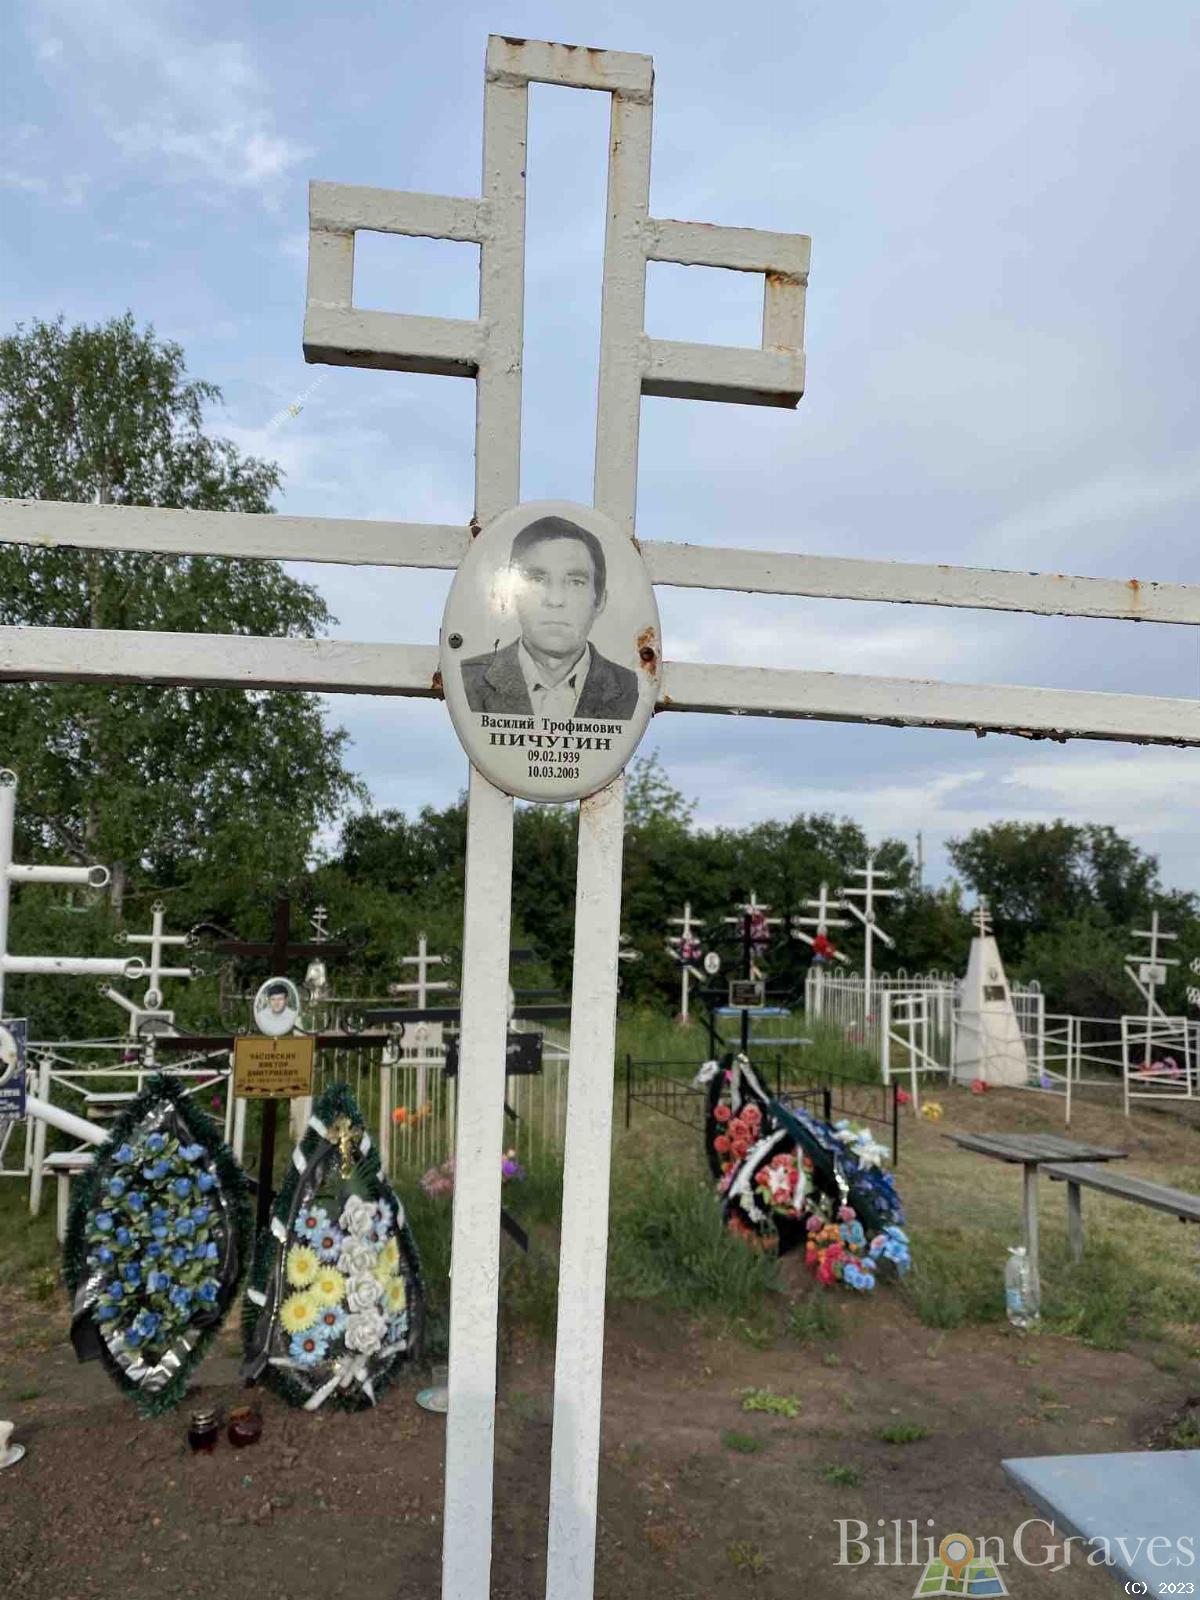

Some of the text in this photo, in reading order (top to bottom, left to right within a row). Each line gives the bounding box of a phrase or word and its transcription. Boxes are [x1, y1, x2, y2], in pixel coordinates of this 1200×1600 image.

[480, 715, 623, 735] Василий Трофимович
[489, 732, 613, 751] ПИЧУГИН
[528, 750, 580, 763] 09.02.1939
[528, 765, 580, 779] 10.03.2003
